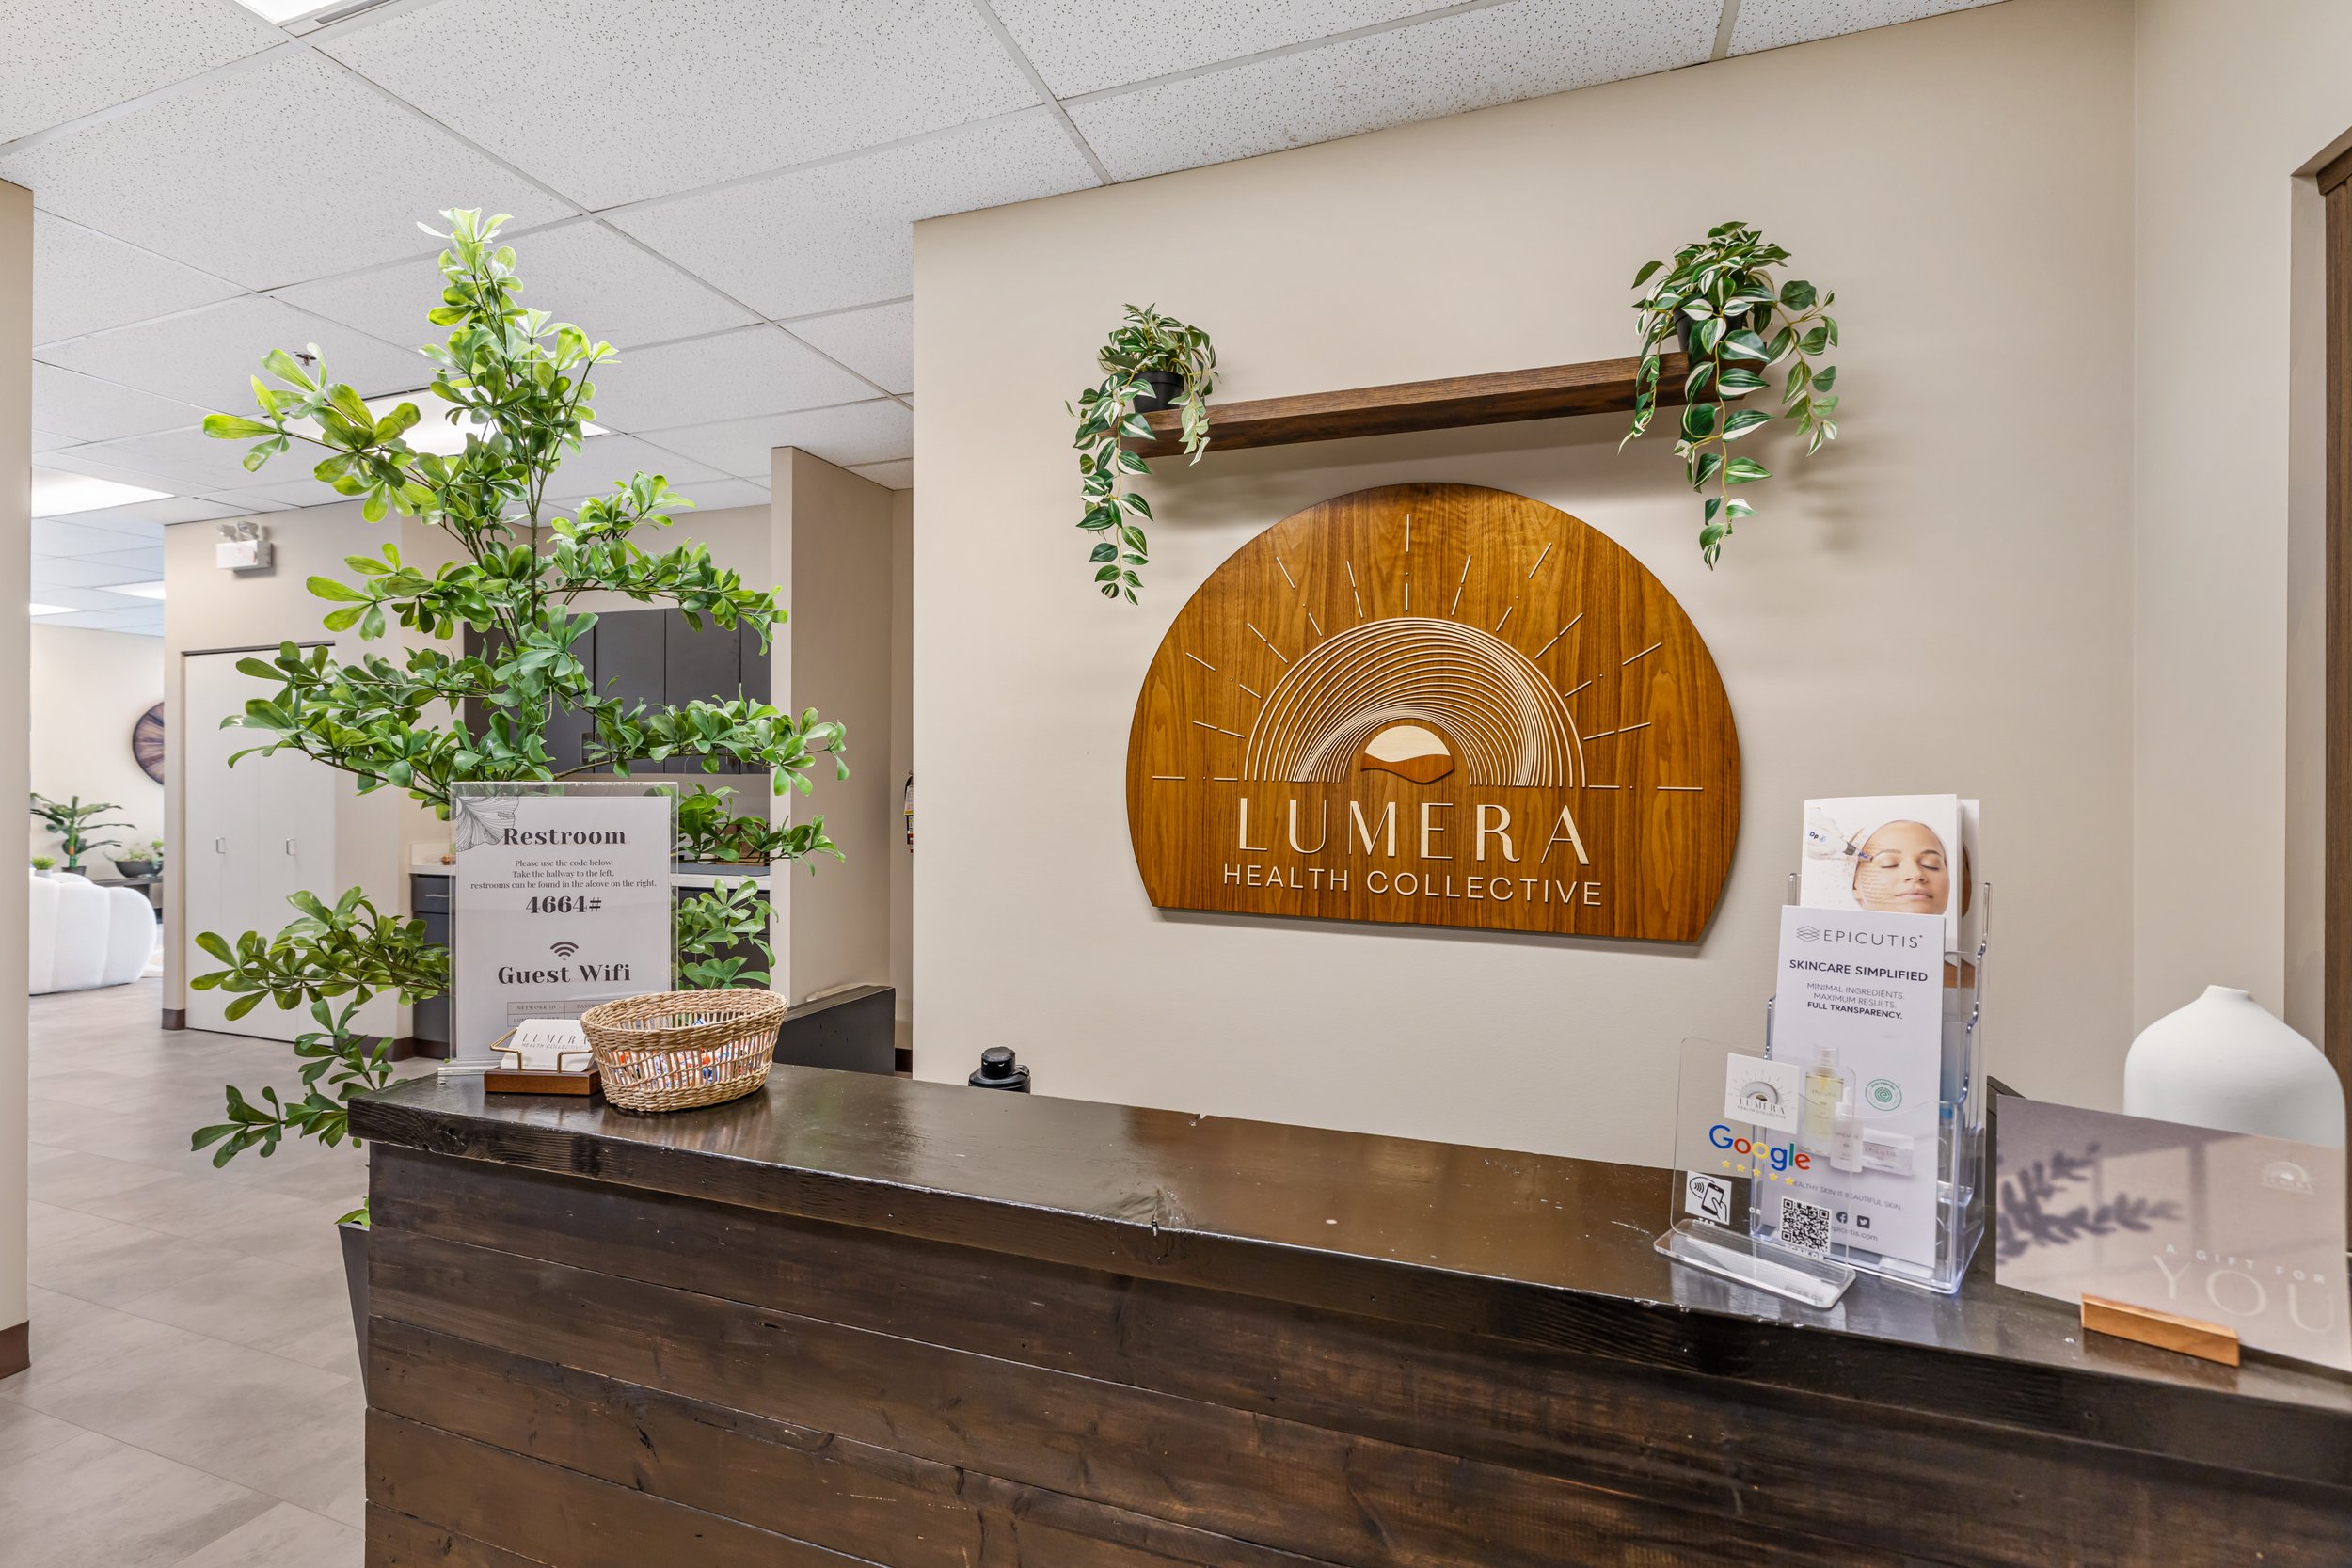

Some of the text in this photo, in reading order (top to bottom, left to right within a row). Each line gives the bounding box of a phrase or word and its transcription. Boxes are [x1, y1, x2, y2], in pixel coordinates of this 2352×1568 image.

[503, 828, 627, 846] Restroom
[1239, 798, 1590, 865] LUMERA
[515, 859, 539, 867] Please
[555, 859, 568, 867] the
[589, 858, 613, 866] below.
[546, 869, 574, 879] hallway
[636, 879, 657, 889] right.
[1224, 863, 1601, 906] HEALTH COLLECTIVE
[526, 895, 602, 914] 4664#
[498, 963, 631, 985] Guest Wifi
[1789, 959, 1929, 982] SKINCARE SIMPLIFIED
[1806, 982, 1905, 1000] MINIMAL INGREDIENTS.
[1814, 992, 1897, 1009] MAXIMUM RESULTS.
[1807, 1001, 1903, 1020] FULL TRANSPARENCY.
[1708, 1124, 1811, 1172] Google
[2166, 1244, 2326, 1285] A GIFT FOR
[2153, 1254, 2335, 1333] YOU
